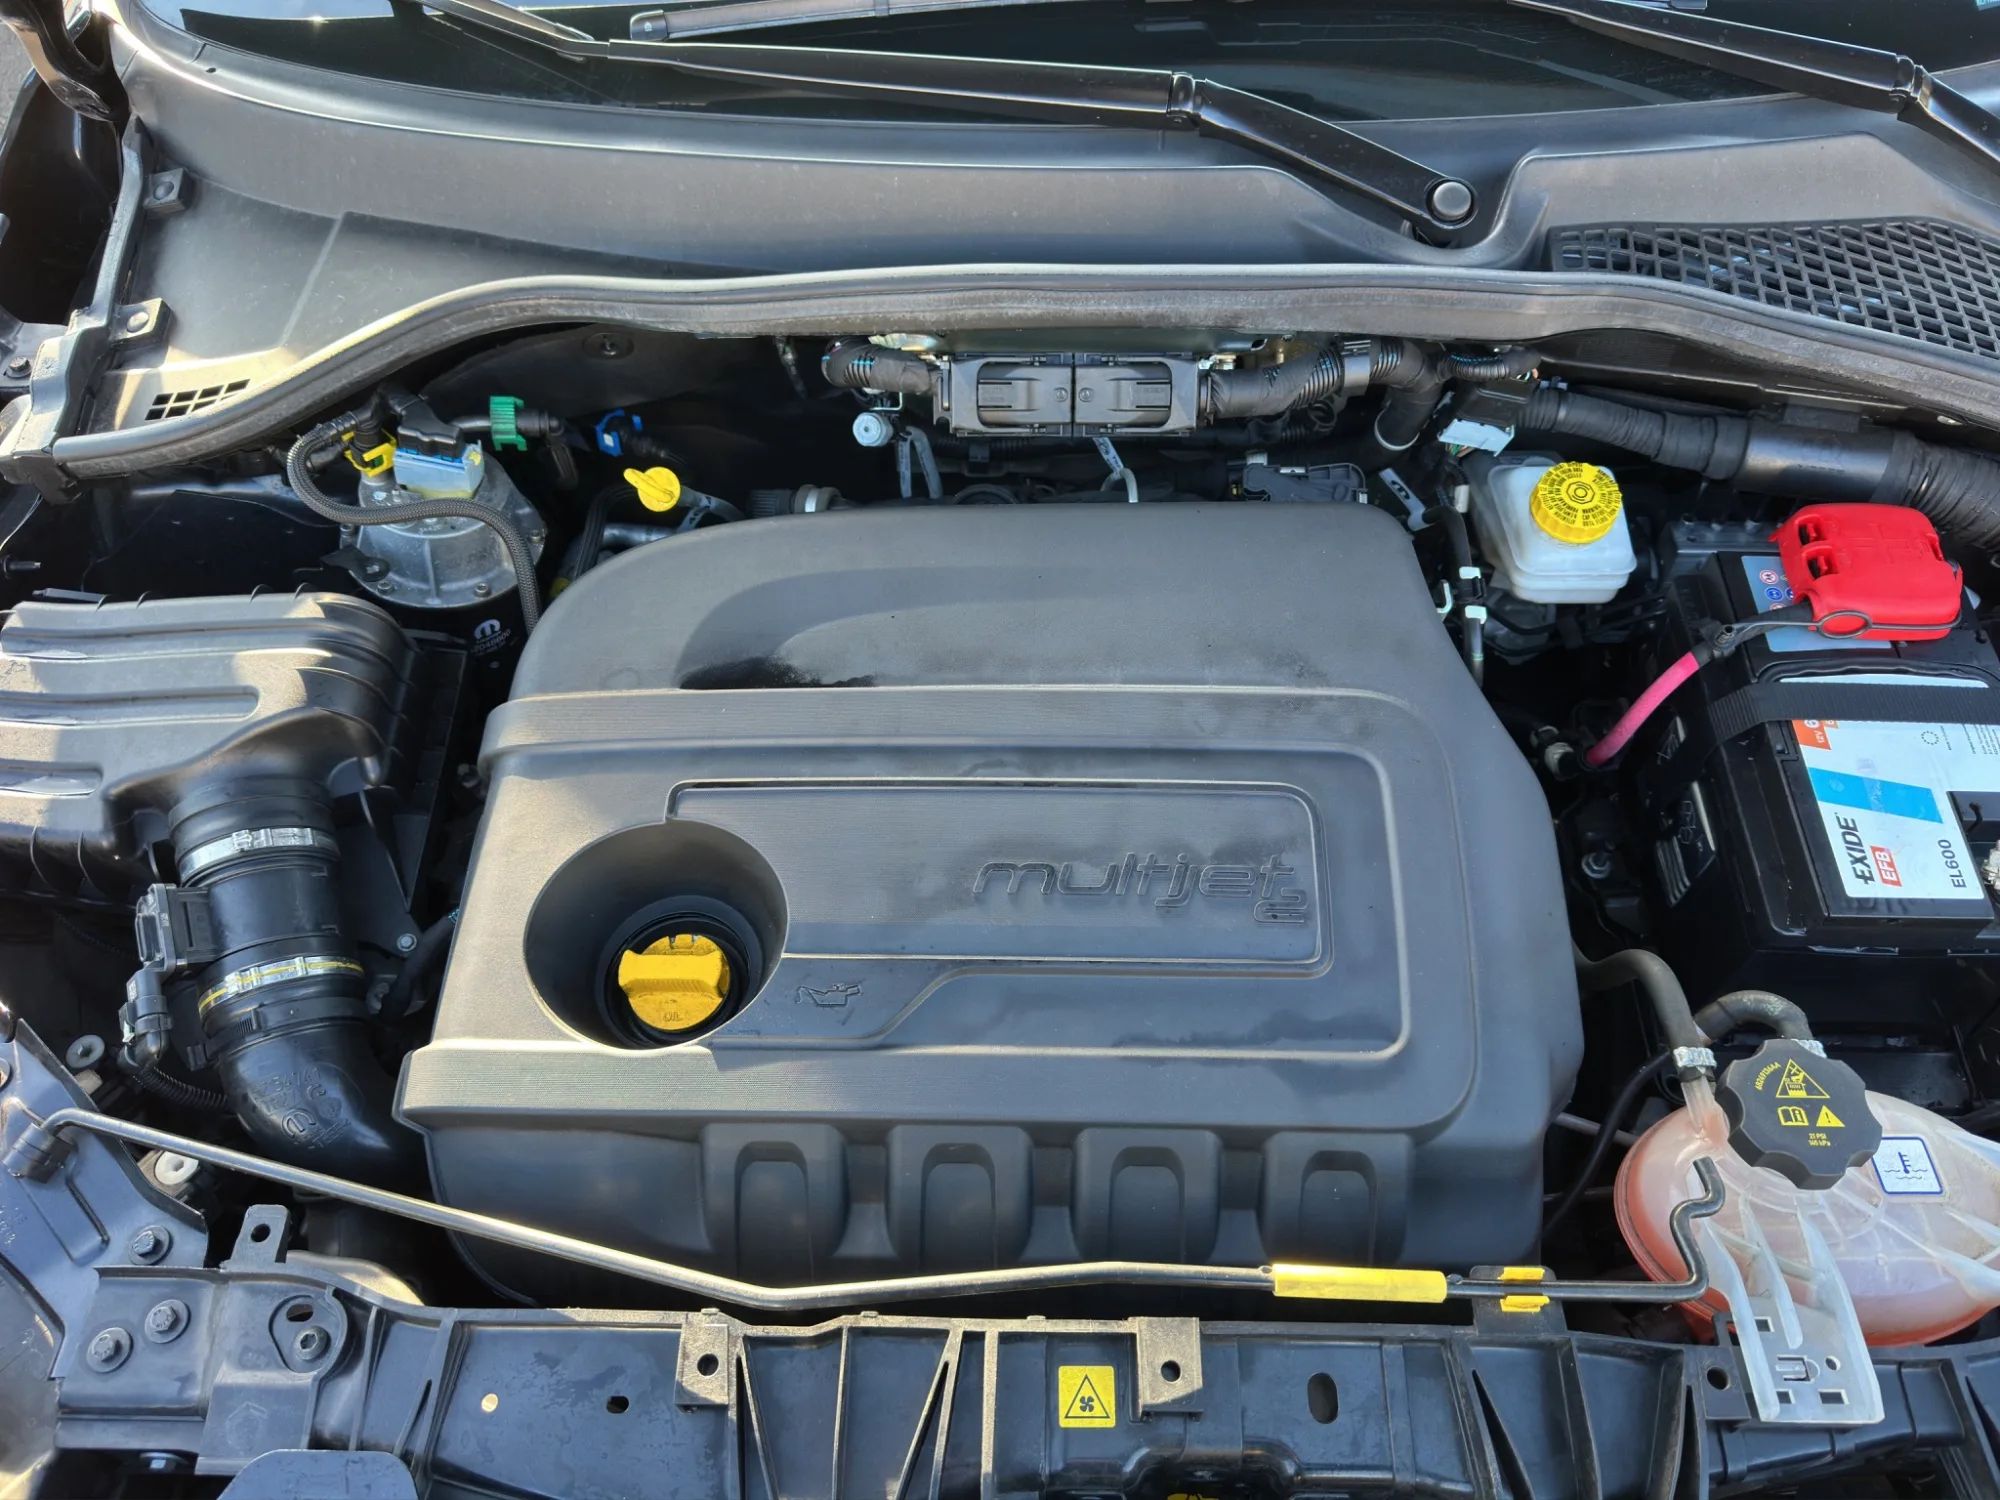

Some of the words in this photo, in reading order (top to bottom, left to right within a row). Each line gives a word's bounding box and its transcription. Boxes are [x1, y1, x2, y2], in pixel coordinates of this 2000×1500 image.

[1835, 814, 1875, 885] EXIDE
[1875, 851, 1898, 882] EFB
[1938, 839, 1967, 888] EL600
